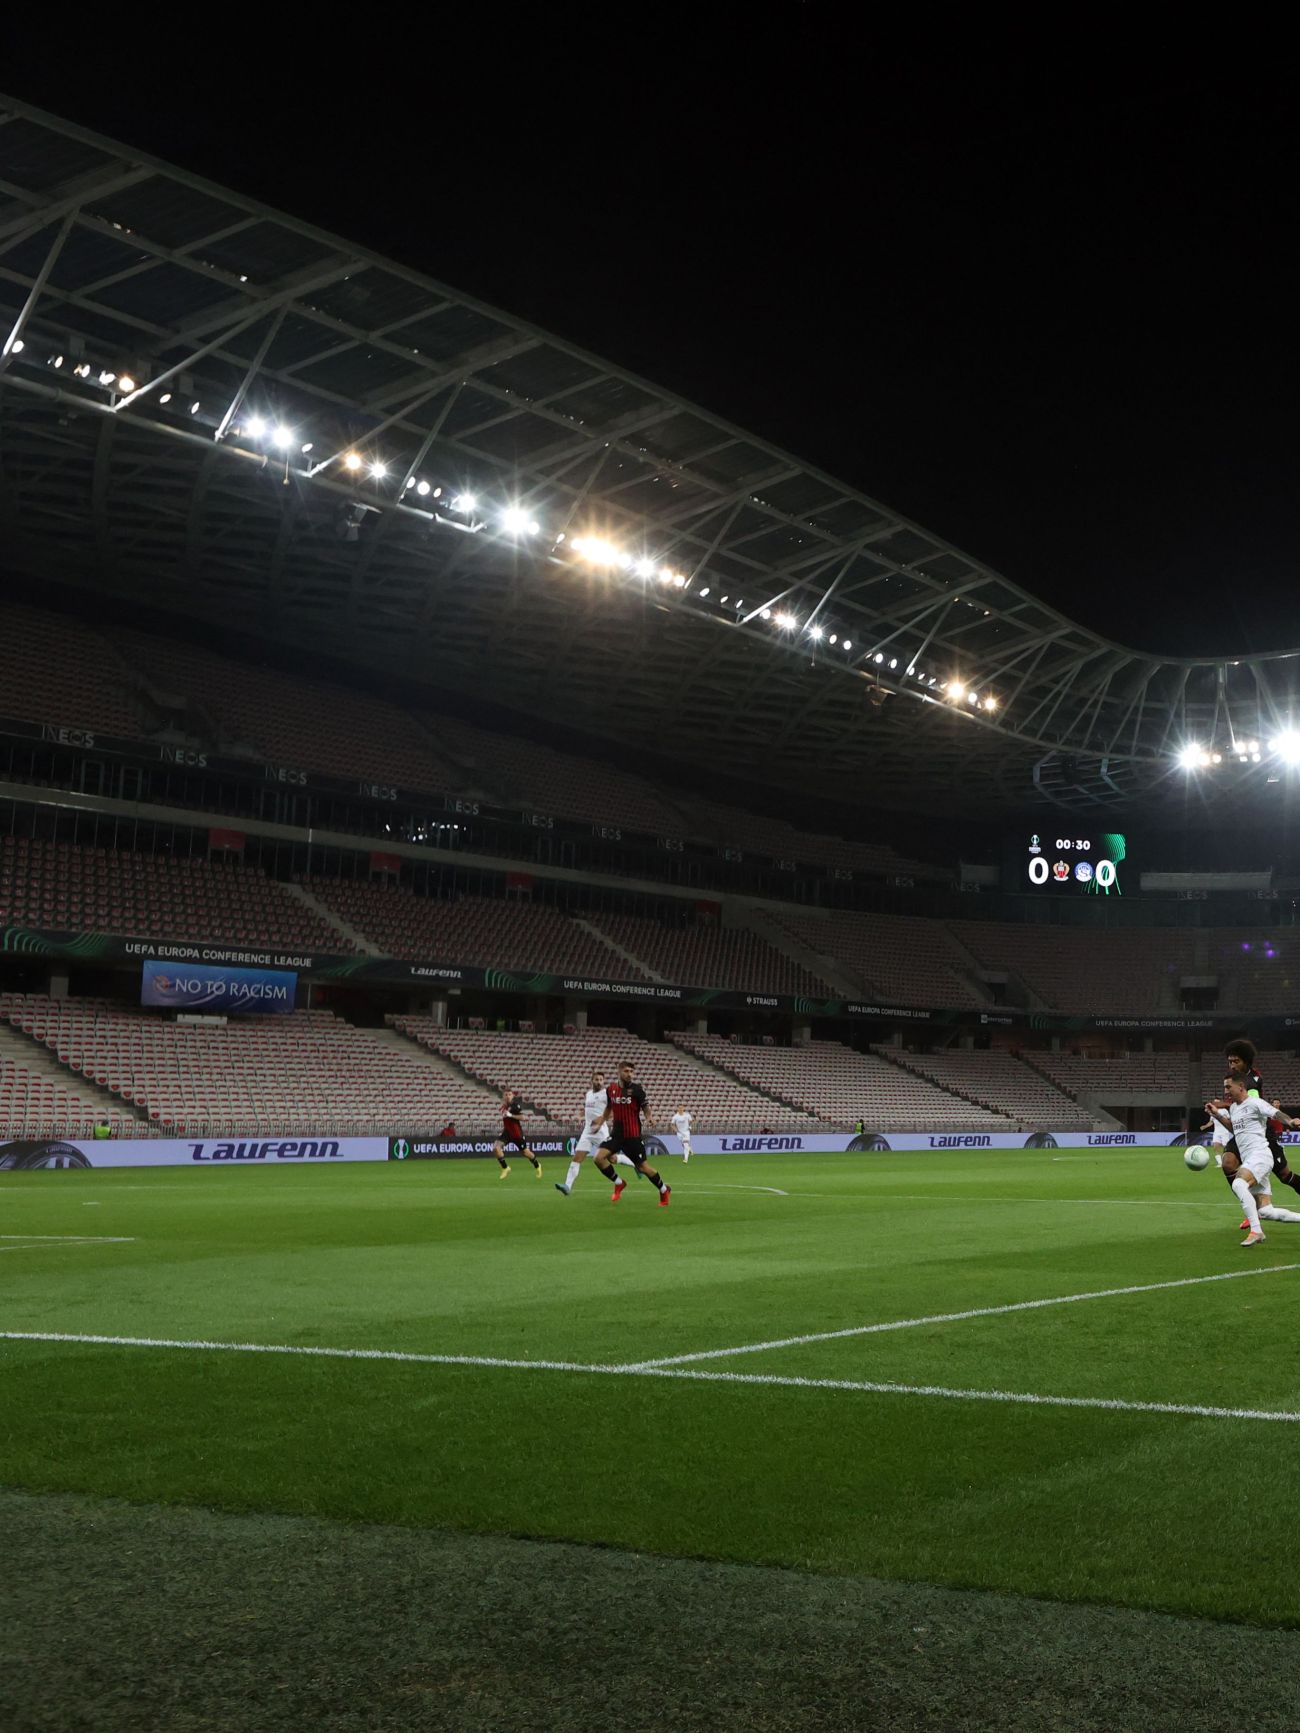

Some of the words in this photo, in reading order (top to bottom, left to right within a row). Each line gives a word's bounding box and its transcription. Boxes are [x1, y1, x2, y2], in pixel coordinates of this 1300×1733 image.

[41, 725, 95, 748] INEOS
[160, 745, 208, 768] INEOS
[265, 764, 307, 785] INEOS
[359, 782, 397, 800] INEOS
[445, 797, 480, 816] INEOS
[1056, 839, 1091, 850] 00:30
[1028, 857, 1049, 885] 0
[1095, 860, 1116, 887] 0
[125, 943, 155, 955] UEFA
[158, 945, 200, 959] EUROPA
[202, 949, 271, 965] CONFERENCE
[275, 955, 312, 968] LEAGUE
[175, 978, 201, 994] NO
[205, 980, 226, 995] TO
[230, 982, 287, 1000] RACISM
[563, 980, 582, 990] UEFA
[584, 981, 611, 992] EUROPA
[612, 984, 655, 996] CONFERENCE
[657, 988, 682, 998] LEAGUE
[414, 1143, 437, 1153] UEFA
[440, 1143, 474, 1153] EUROPA
[532, 1142, 563, 1151] LEAGUE
